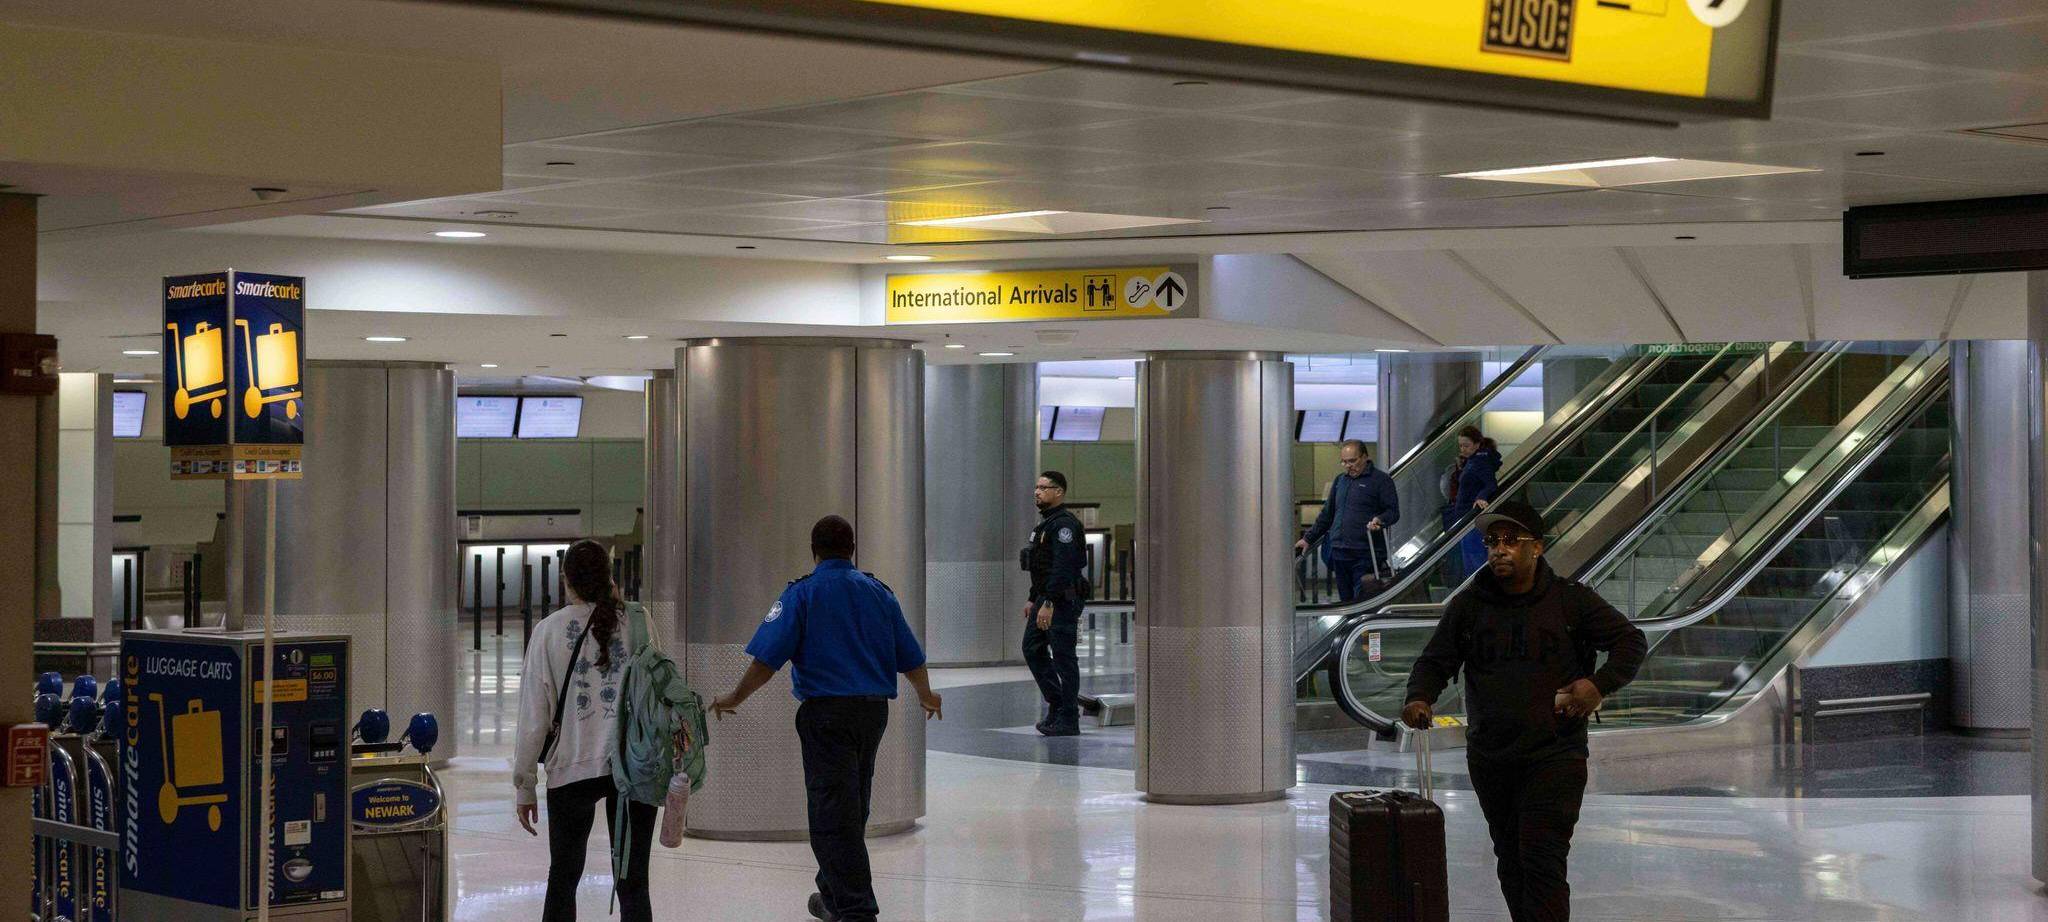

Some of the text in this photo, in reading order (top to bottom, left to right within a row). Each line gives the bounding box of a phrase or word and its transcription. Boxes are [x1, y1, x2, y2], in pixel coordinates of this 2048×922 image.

[1500, 0, 1558, 49] USO
[167, 279, 226, 300] smartecarte
[235, 280, 300, 300] smartecarte
[892, 283, 1078, 308] International Arrivals
[1477, 624, 1562, 663] GAP
[146, 656, 233, 681] LUGGAGE CARTS
[312, 671, 334, 680] $6.00
[124, 655, 141, 879] smartecarte
[365, 804, 415, 819] NEWARK
[368, 794, 409, 804] Welcome to
[56, 779, 71, 898] smaecarte
[93, 786, 106, 909] smaecarte
